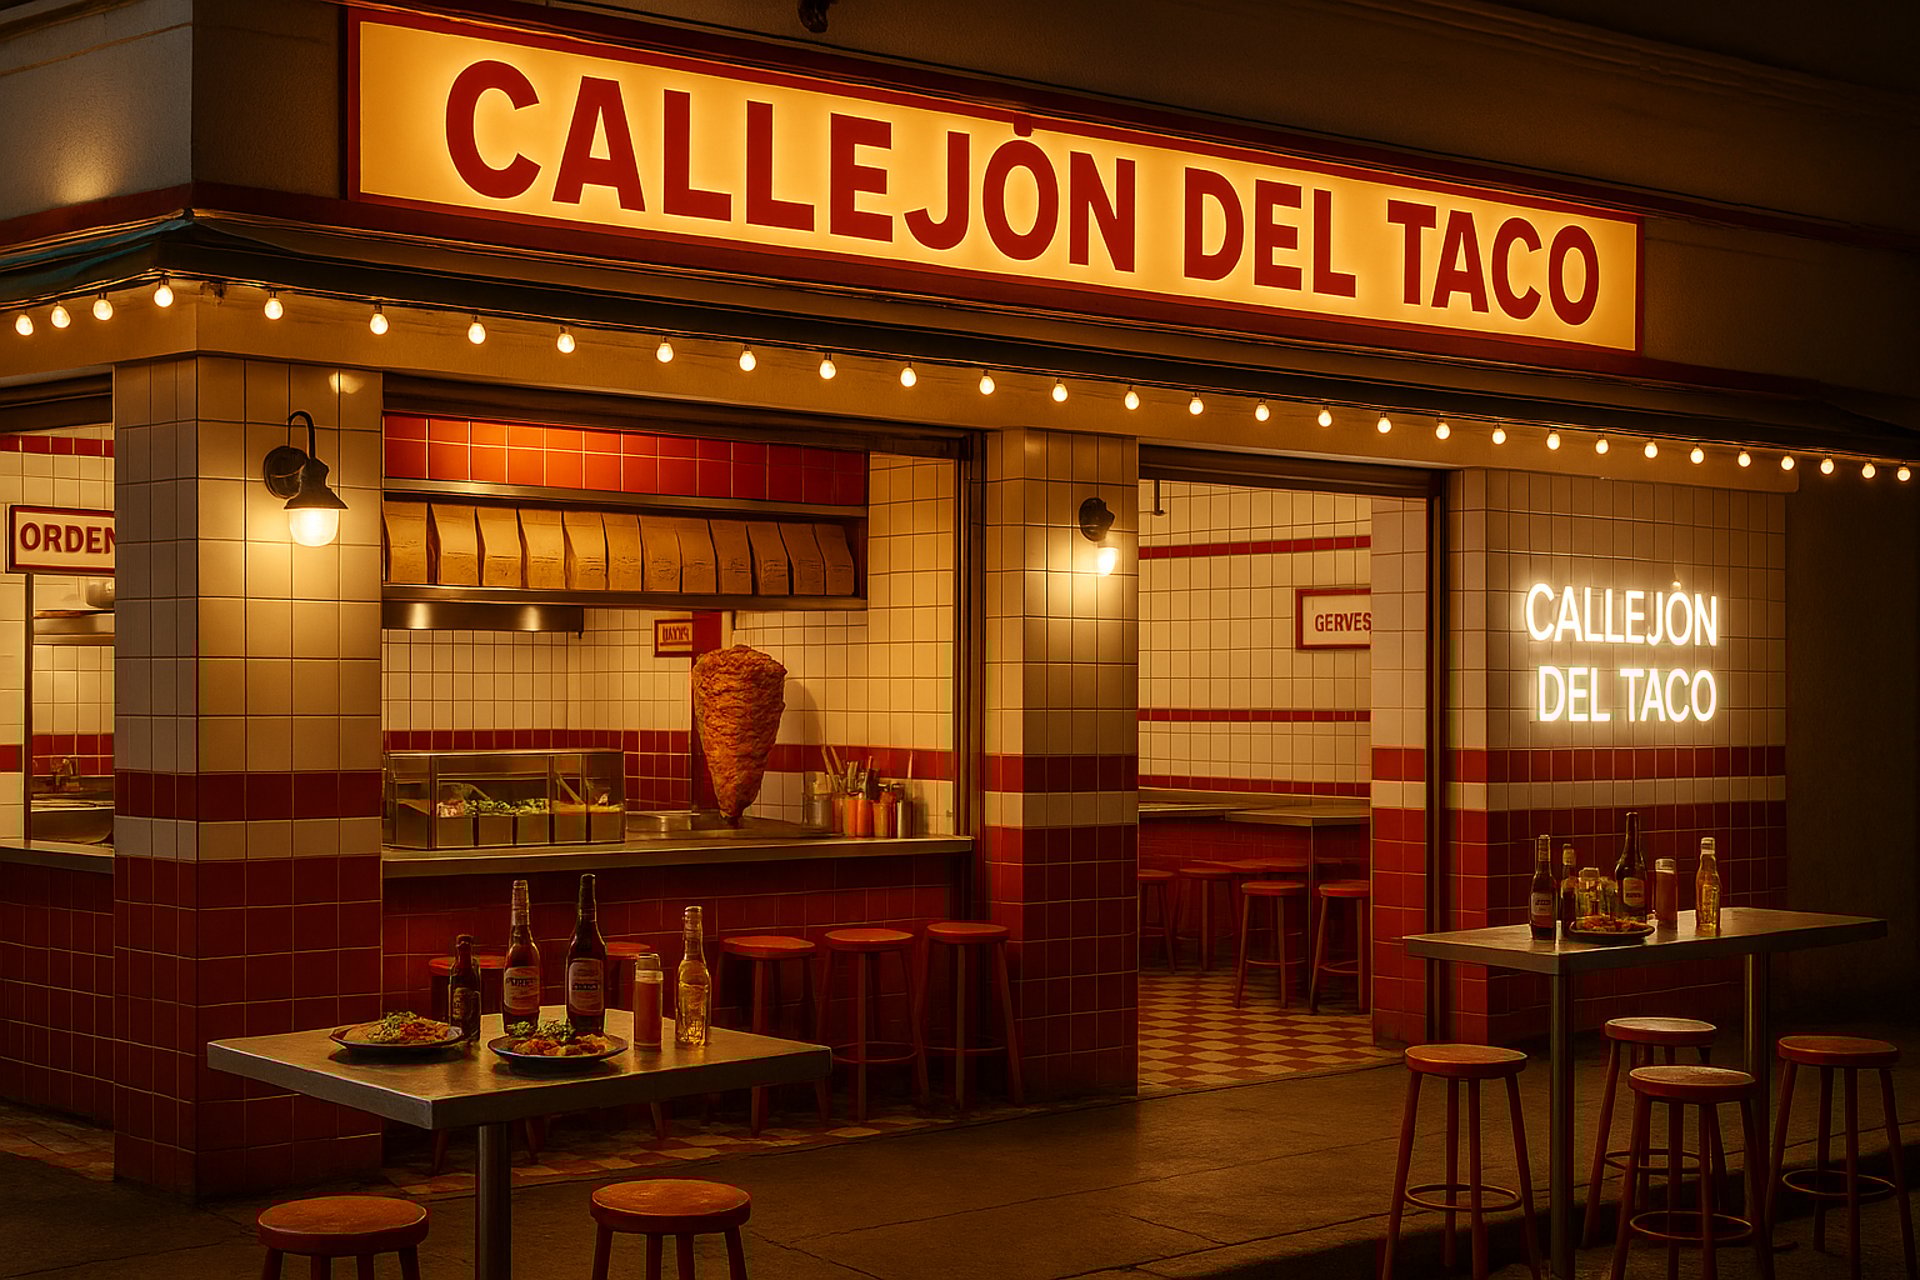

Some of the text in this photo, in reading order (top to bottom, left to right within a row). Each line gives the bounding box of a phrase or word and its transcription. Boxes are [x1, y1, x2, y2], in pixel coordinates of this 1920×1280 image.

[1185, 168, 1357, 298] DEL
[1388, 199, 1600, 326] TACO
[1538, 666, 1717, 722] DEL TACO
